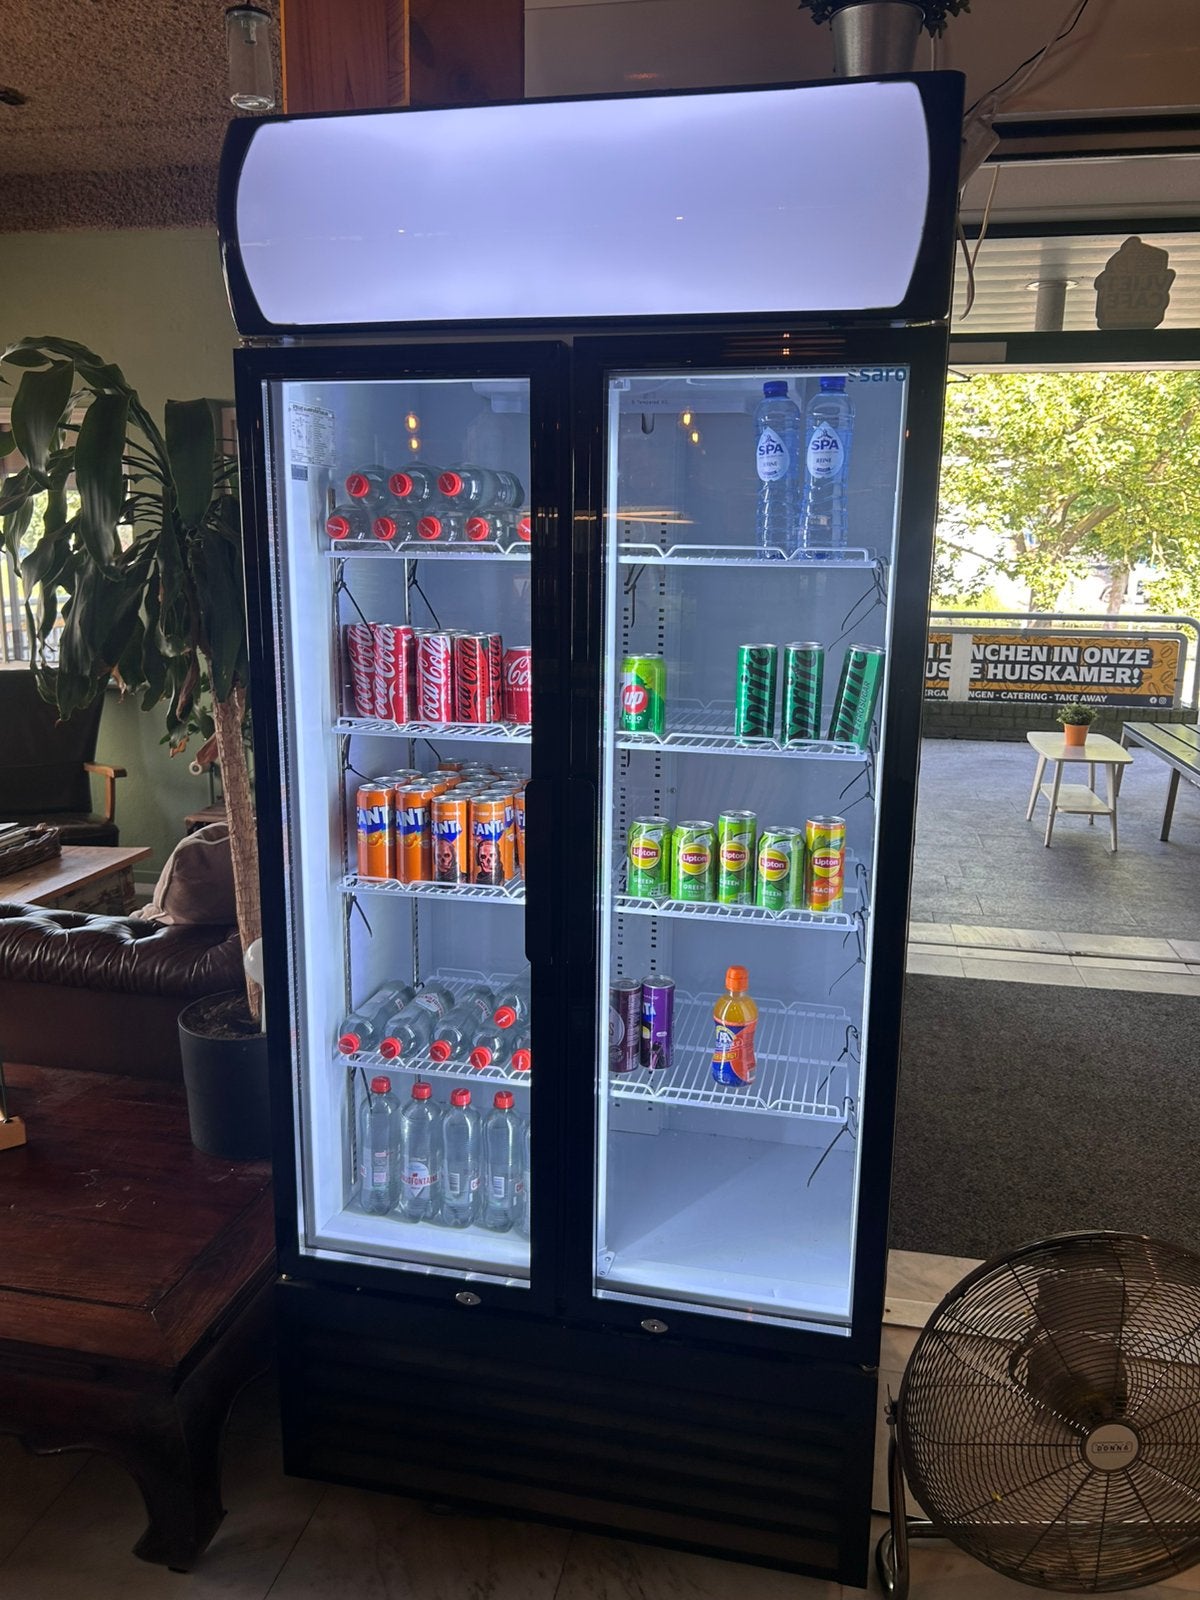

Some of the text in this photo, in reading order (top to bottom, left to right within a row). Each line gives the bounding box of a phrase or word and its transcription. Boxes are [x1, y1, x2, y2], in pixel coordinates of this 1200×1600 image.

[758, 443, 784, 455] SPA
[811, 439, 839, 450] SPA
[940, 643, 1048, 662] LNCHEN
[1053, 646, 1079, 663] IN
[1083, 646, 1150, 665] ONZE
[458, 638, 478, 720] oca-Cola
[987, 663, 1141, 684] HUISKAMER!
[1001, 691, 1047, 700] CATERING
[1054, 694, 1079, 702] TAKE
[1079, 695, 1107, 703] AWAY
[633, 848, 656, 857] Lipton
[683, 854, 707, 862] Lipton
[815, 857, 839, 866] Lipton
